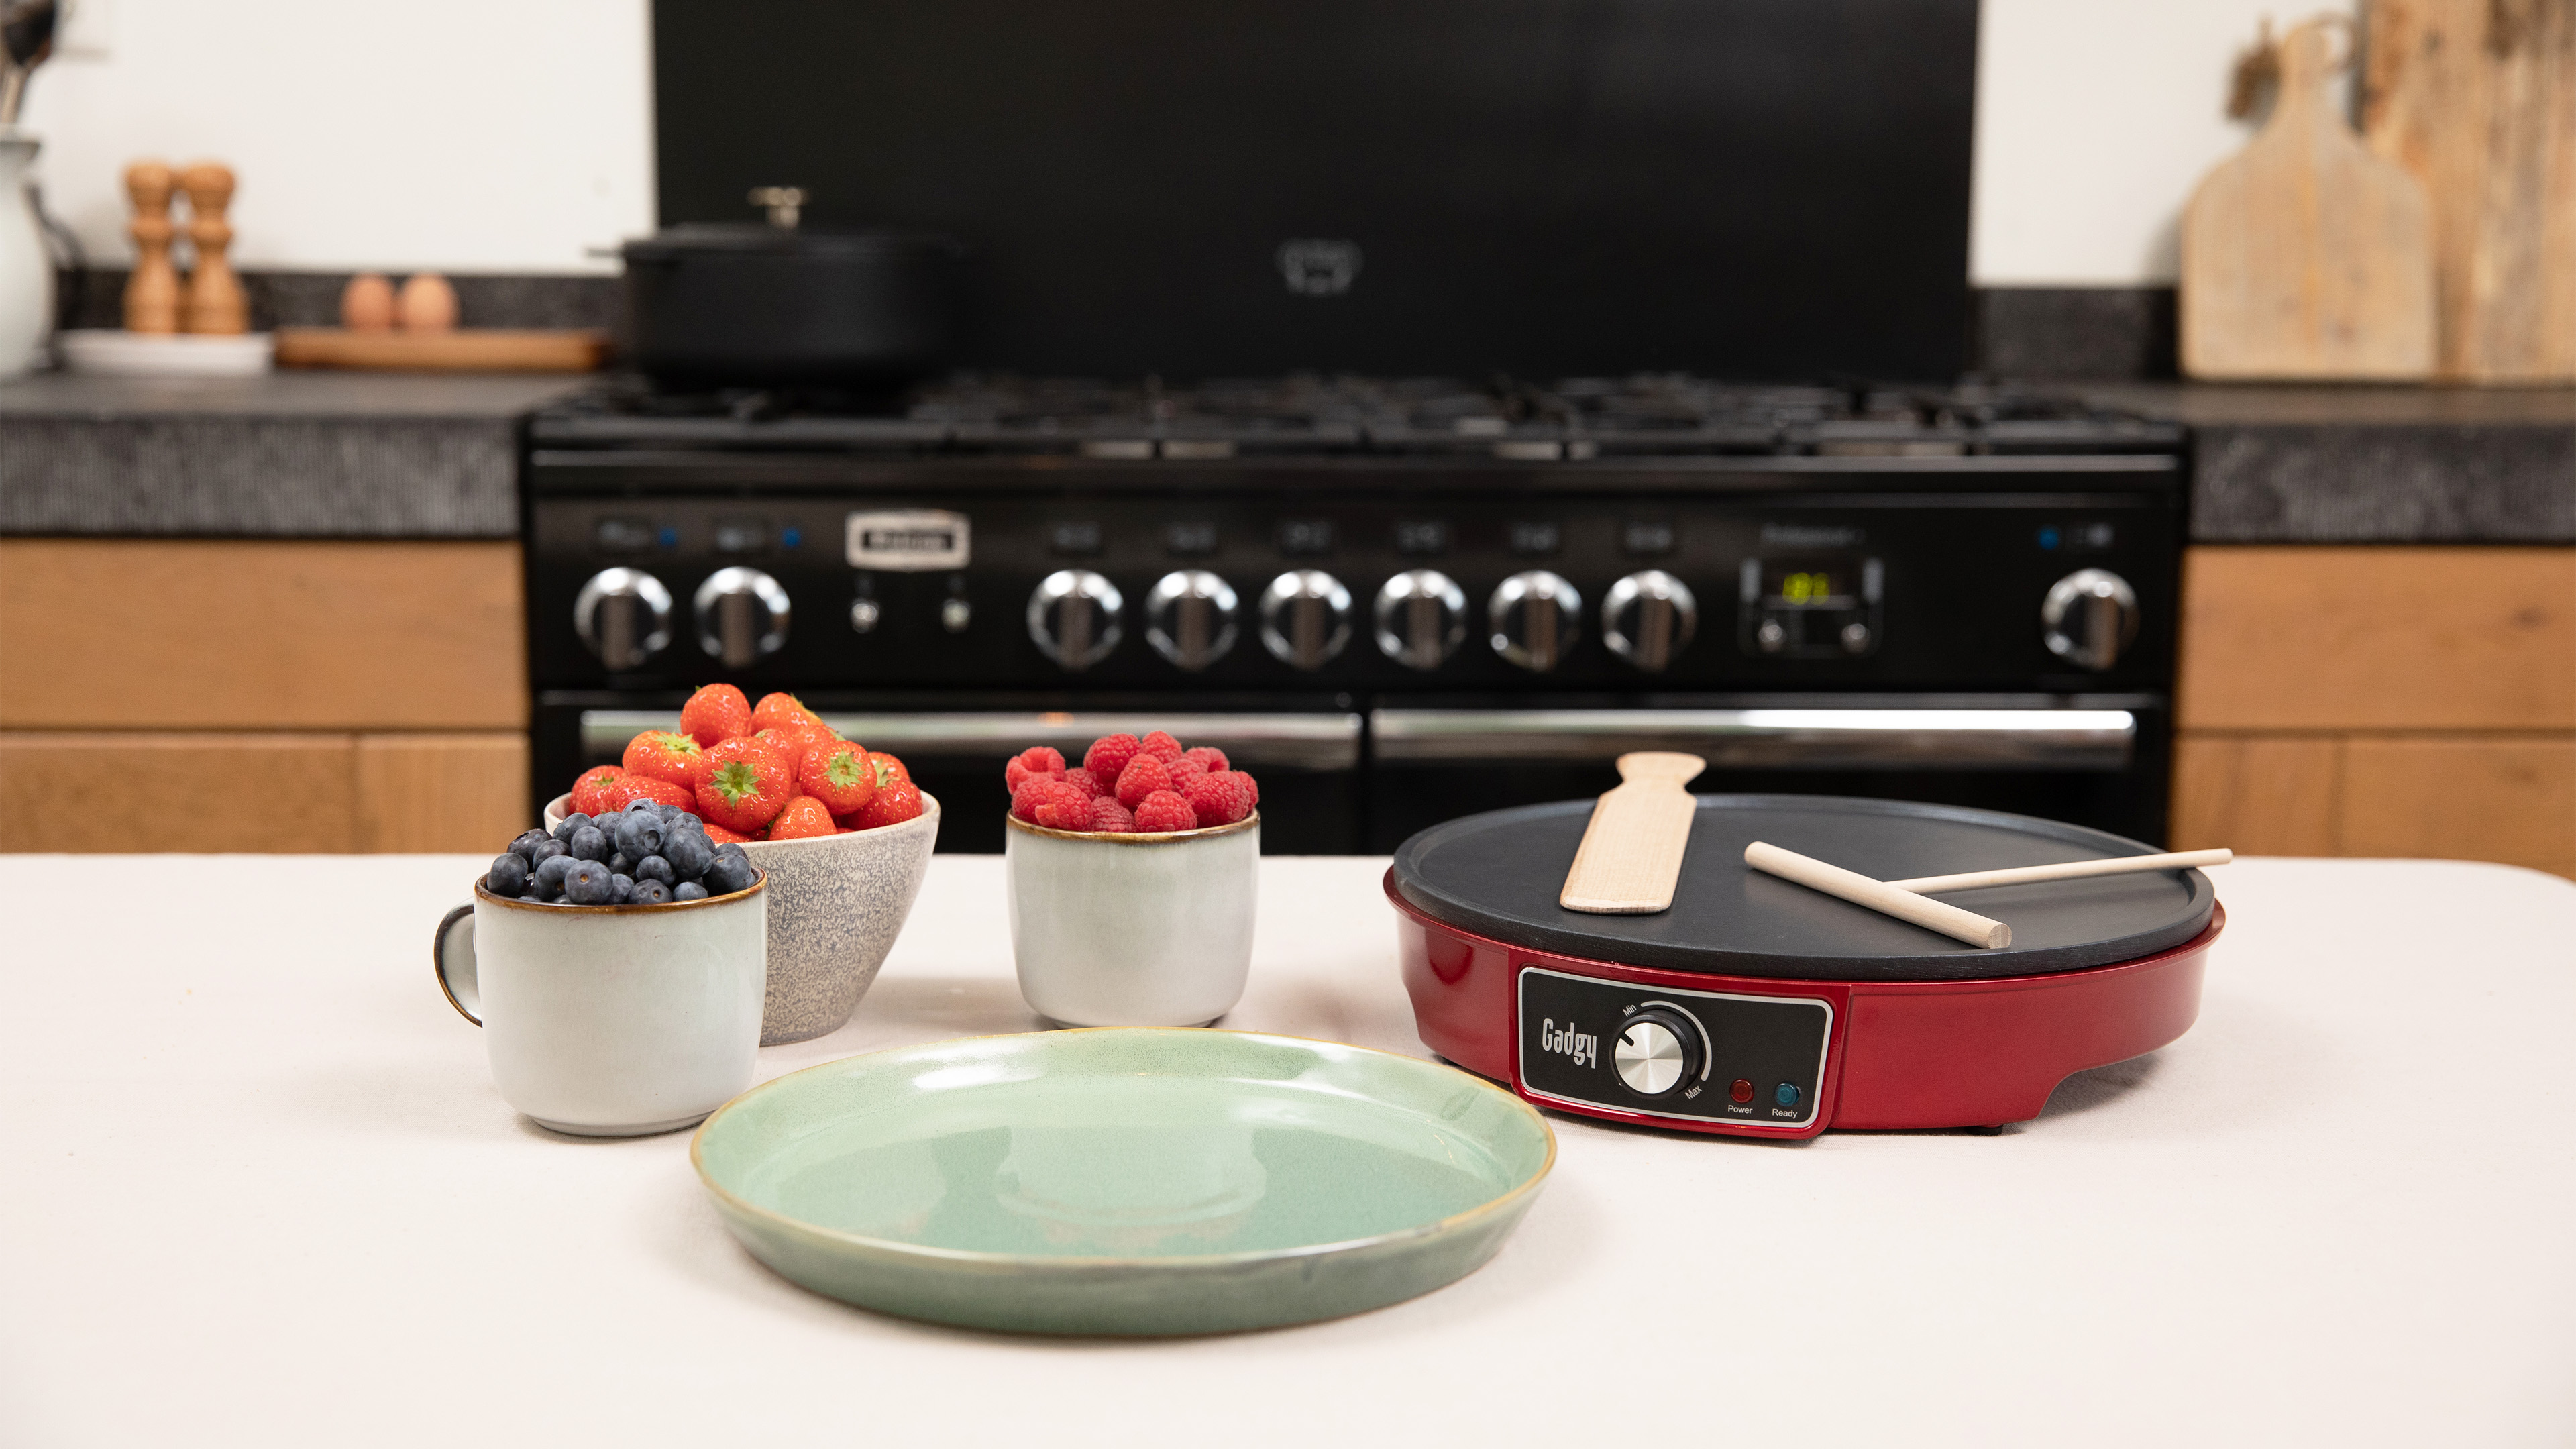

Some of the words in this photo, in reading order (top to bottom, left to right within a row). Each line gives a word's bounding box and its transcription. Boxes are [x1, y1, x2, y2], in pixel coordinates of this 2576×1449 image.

[1622, 1004, 1637, 1017] Min
[1542, 1018, 1597, 1069] Gadgy
[1684, 1085, 1703, 1100] Max
[1727, 1104, 1753, 1114] Power
[1772, 1108, 1798, 1119] Ready
